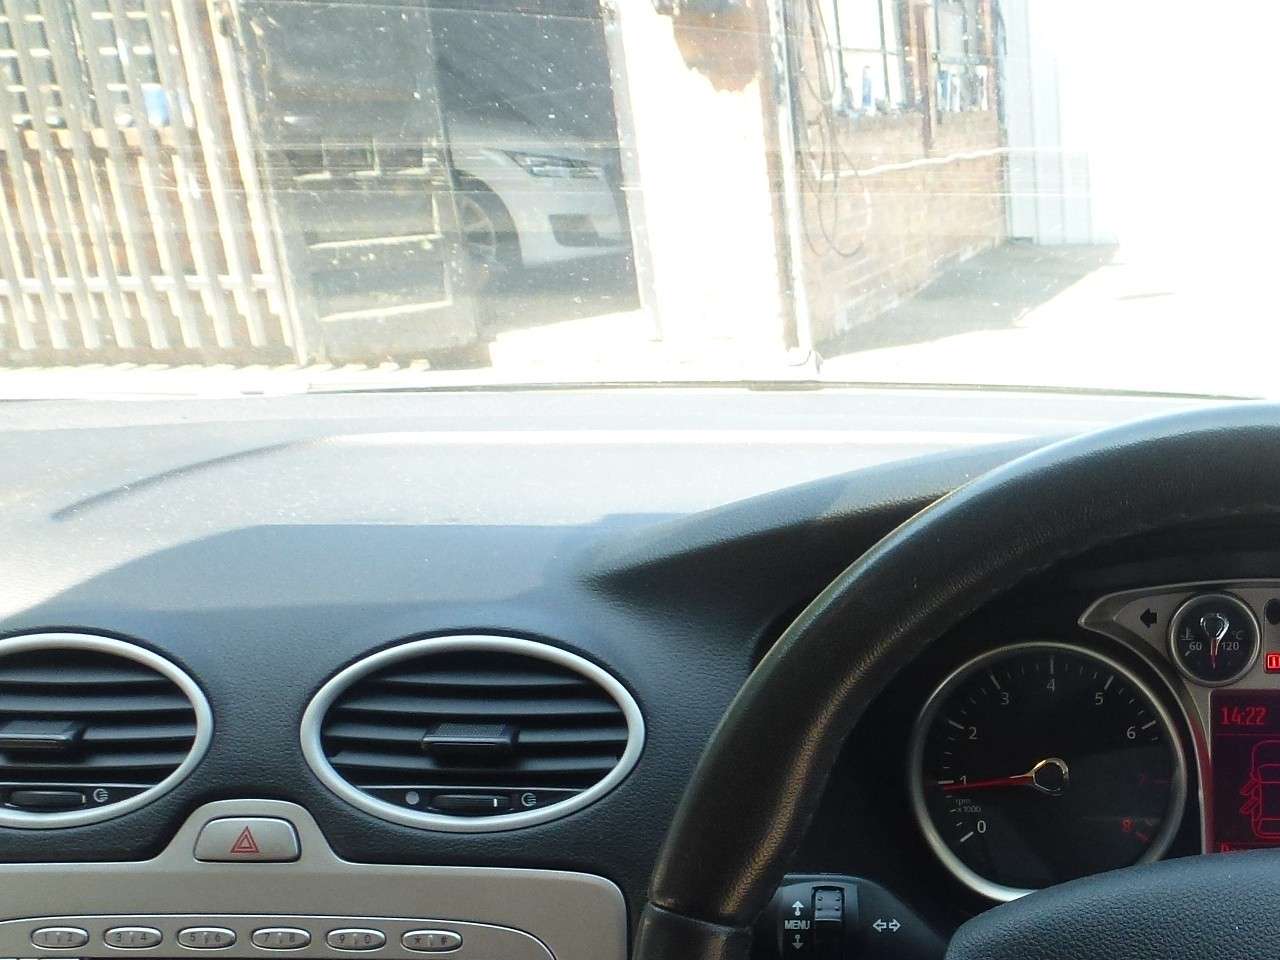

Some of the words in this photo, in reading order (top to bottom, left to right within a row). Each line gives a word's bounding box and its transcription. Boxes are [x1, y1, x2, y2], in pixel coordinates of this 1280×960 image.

[1188, 641, 1202, 651] 60
[1221, 641, 1240, 651] 120
[1046, 678, 1056, 692] 4
[1000, 692, 1010, 705] 3
[1095, 692, 1104, 706] 5
[1220, 706, 1267, 726] 14:22
[968, 726, 978, 740] 2
[1126, 726, 1136, 740] 6
[976, 820, 987, 834] 0
[783, 919, 811, 930] MENU
